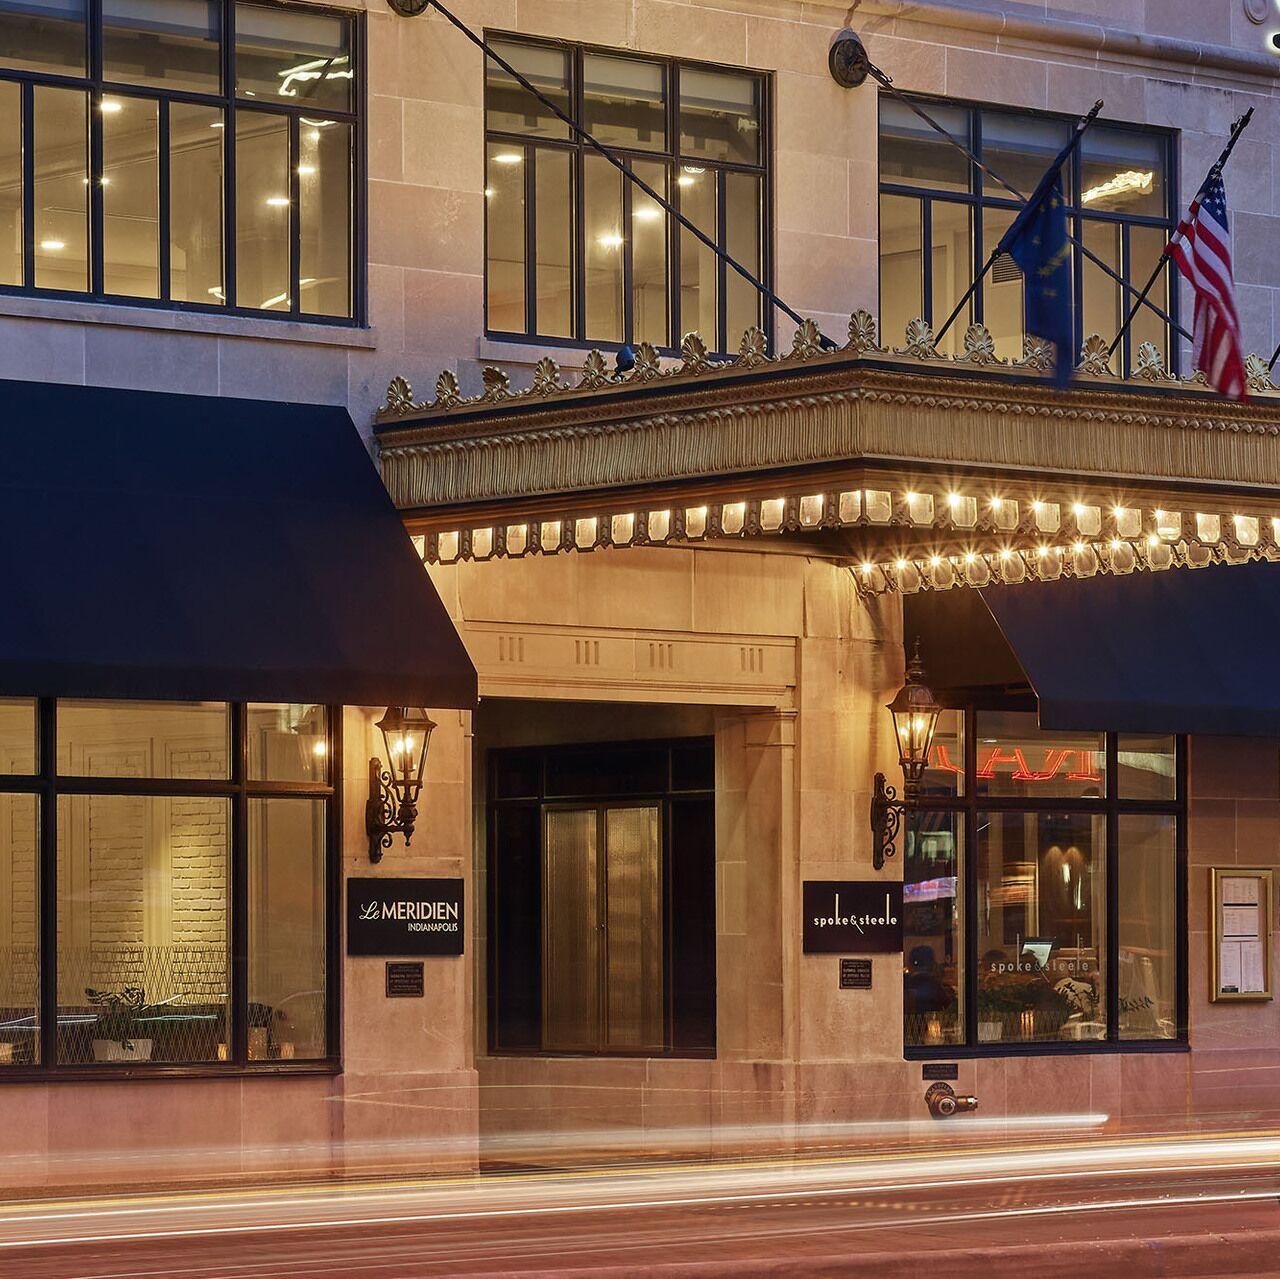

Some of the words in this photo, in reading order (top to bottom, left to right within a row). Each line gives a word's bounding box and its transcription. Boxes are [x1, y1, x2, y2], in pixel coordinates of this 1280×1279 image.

[358, 900, 381, 920] Le
[381, 901, 459, 920] MERIDIEN
[407, 922, 458, 932] INDIANAPOLIS
